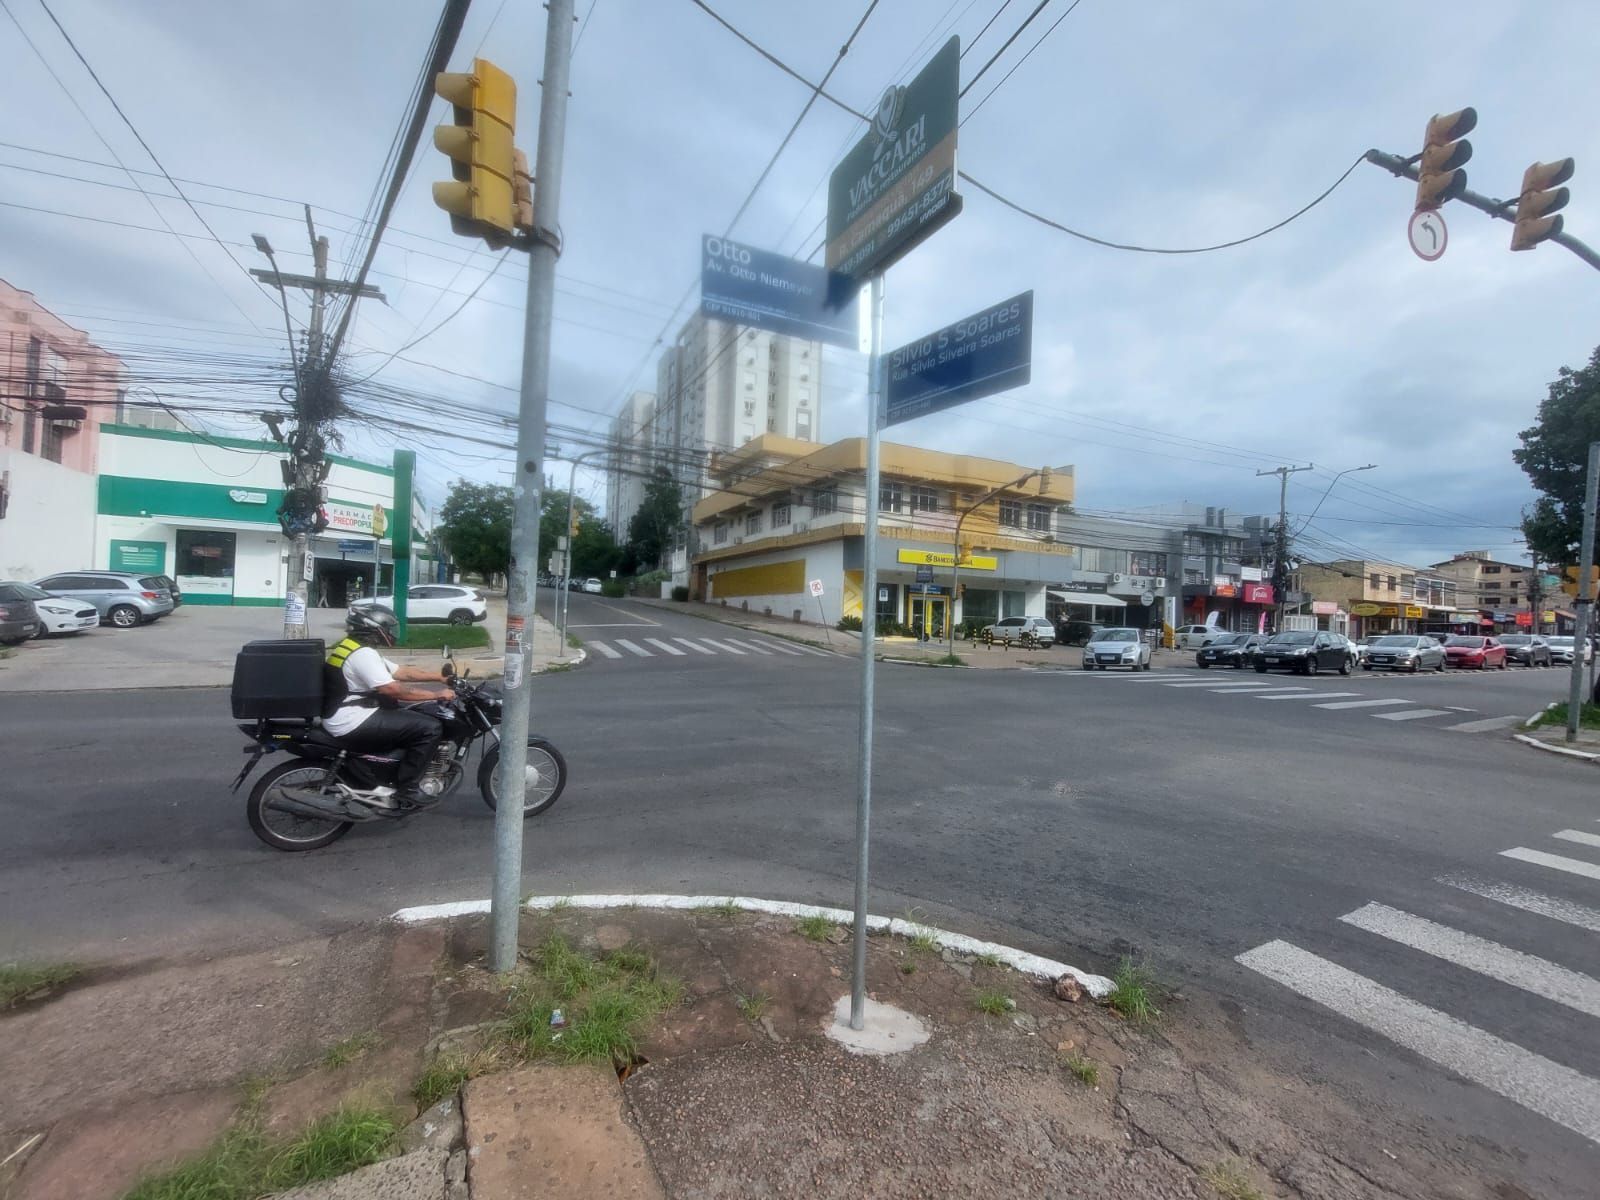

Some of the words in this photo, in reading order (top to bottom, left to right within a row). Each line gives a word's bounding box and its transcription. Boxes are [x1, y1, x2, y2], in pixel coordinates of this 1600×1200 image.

[850, 114, 926, 207] VACCARI
[706, 237, 751, 264] Otto
[706, 258, 726, 273] Av.
[730, 264, 757, 281] Otto
[760, 271, 814, 296] Niemeyer
[892, 341, 932, 368] Silvio
[938, 330, 949, 349] S
[955, 303, 1020, 342] Soares
[892, 370, 908, 382] Rua
[938, 341, 977, 364] Silveira
[980, 324, 1021, 348] Soares
